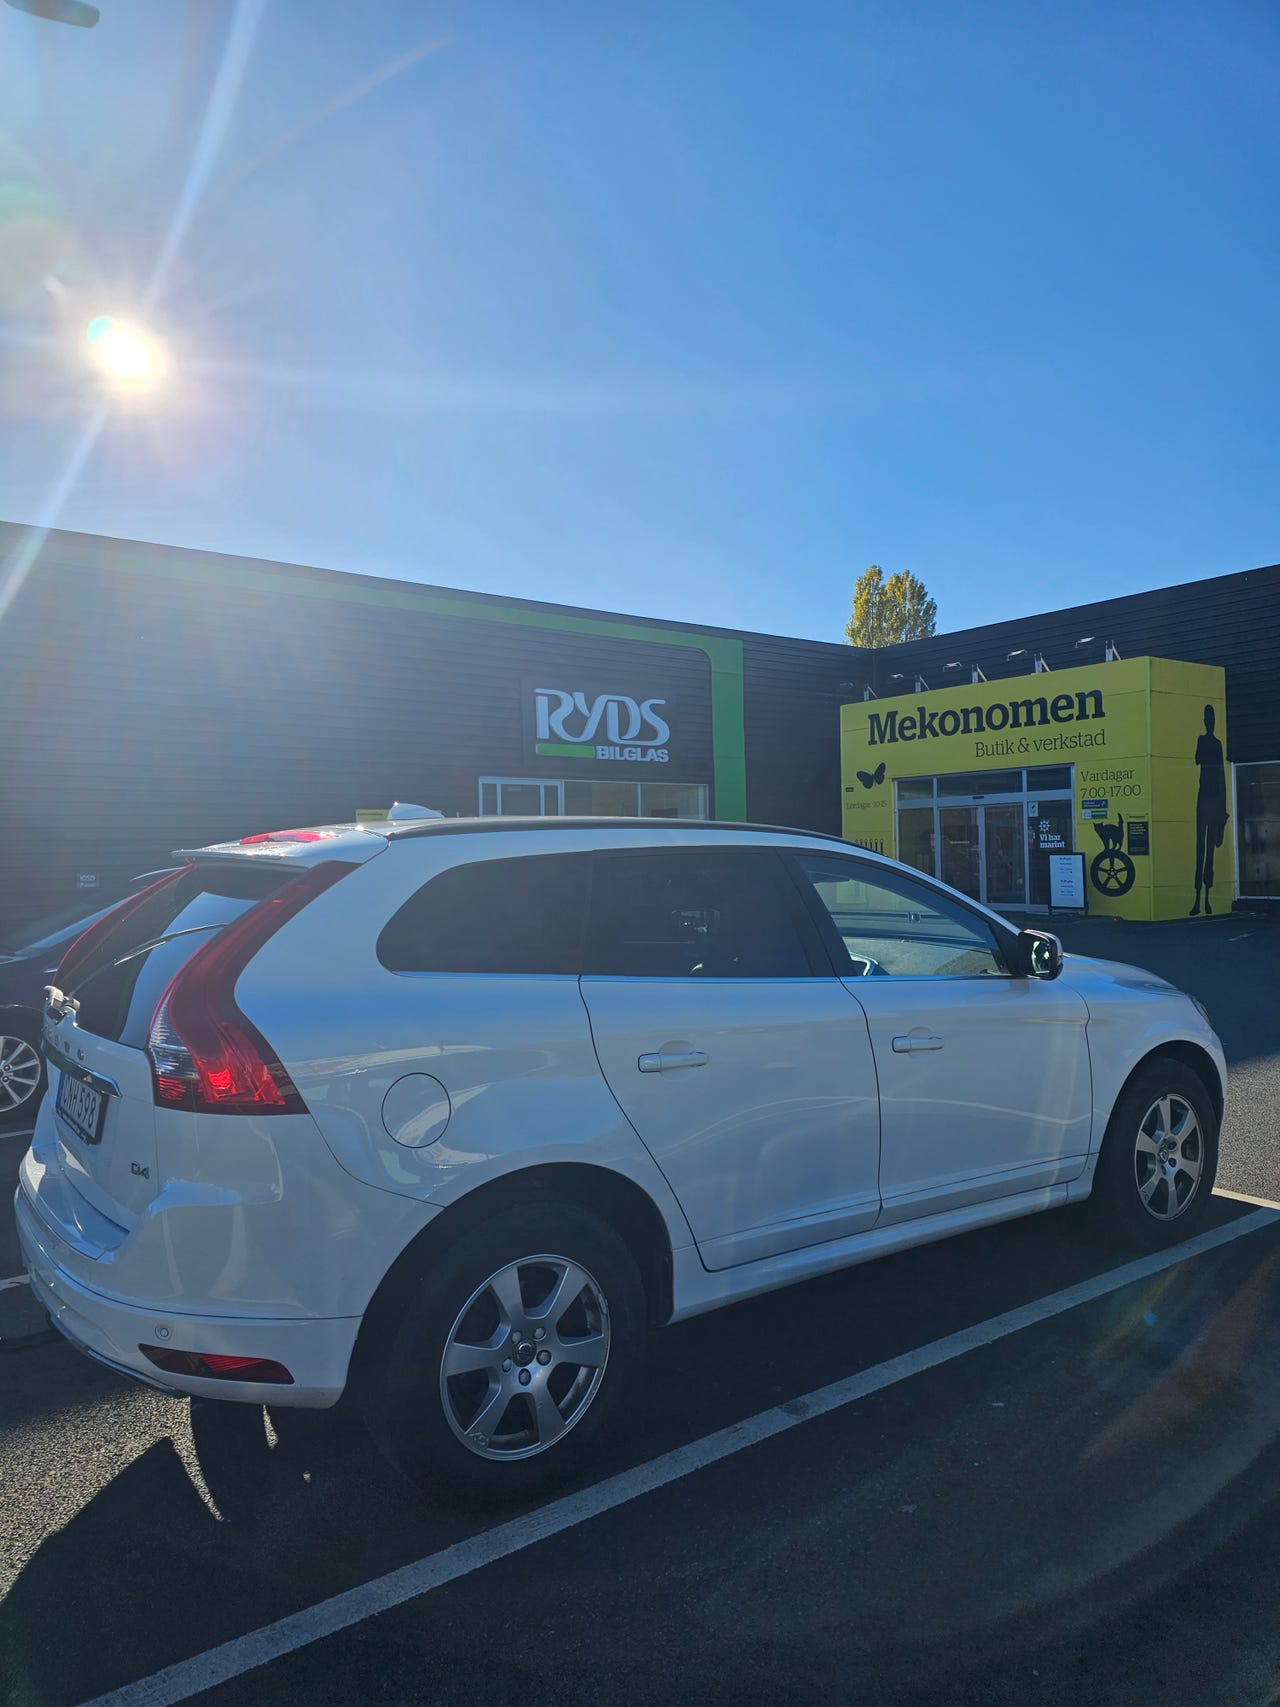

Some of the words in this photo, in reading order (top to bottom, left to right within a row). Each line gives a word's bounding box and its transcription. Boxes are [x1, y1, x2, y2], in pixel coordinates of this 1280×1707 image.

[533, 688, 670, 746] RYDS
[867, 689, 1106, 745] Mekonomen
[595, 746, 669, 763] BILGLAS
[975, 739, 1014, 758] Butik
[1017, 737, 1030, 753] &
[1033, 729, 1106, 752] verkstad
[1080, 769, 1135, 782] Vardagar
[1080, 784, 1142, 799] 7.00-17.00
[78, 1087, 97, 1128] 598
[130, 1161, 150, 1180] D4
